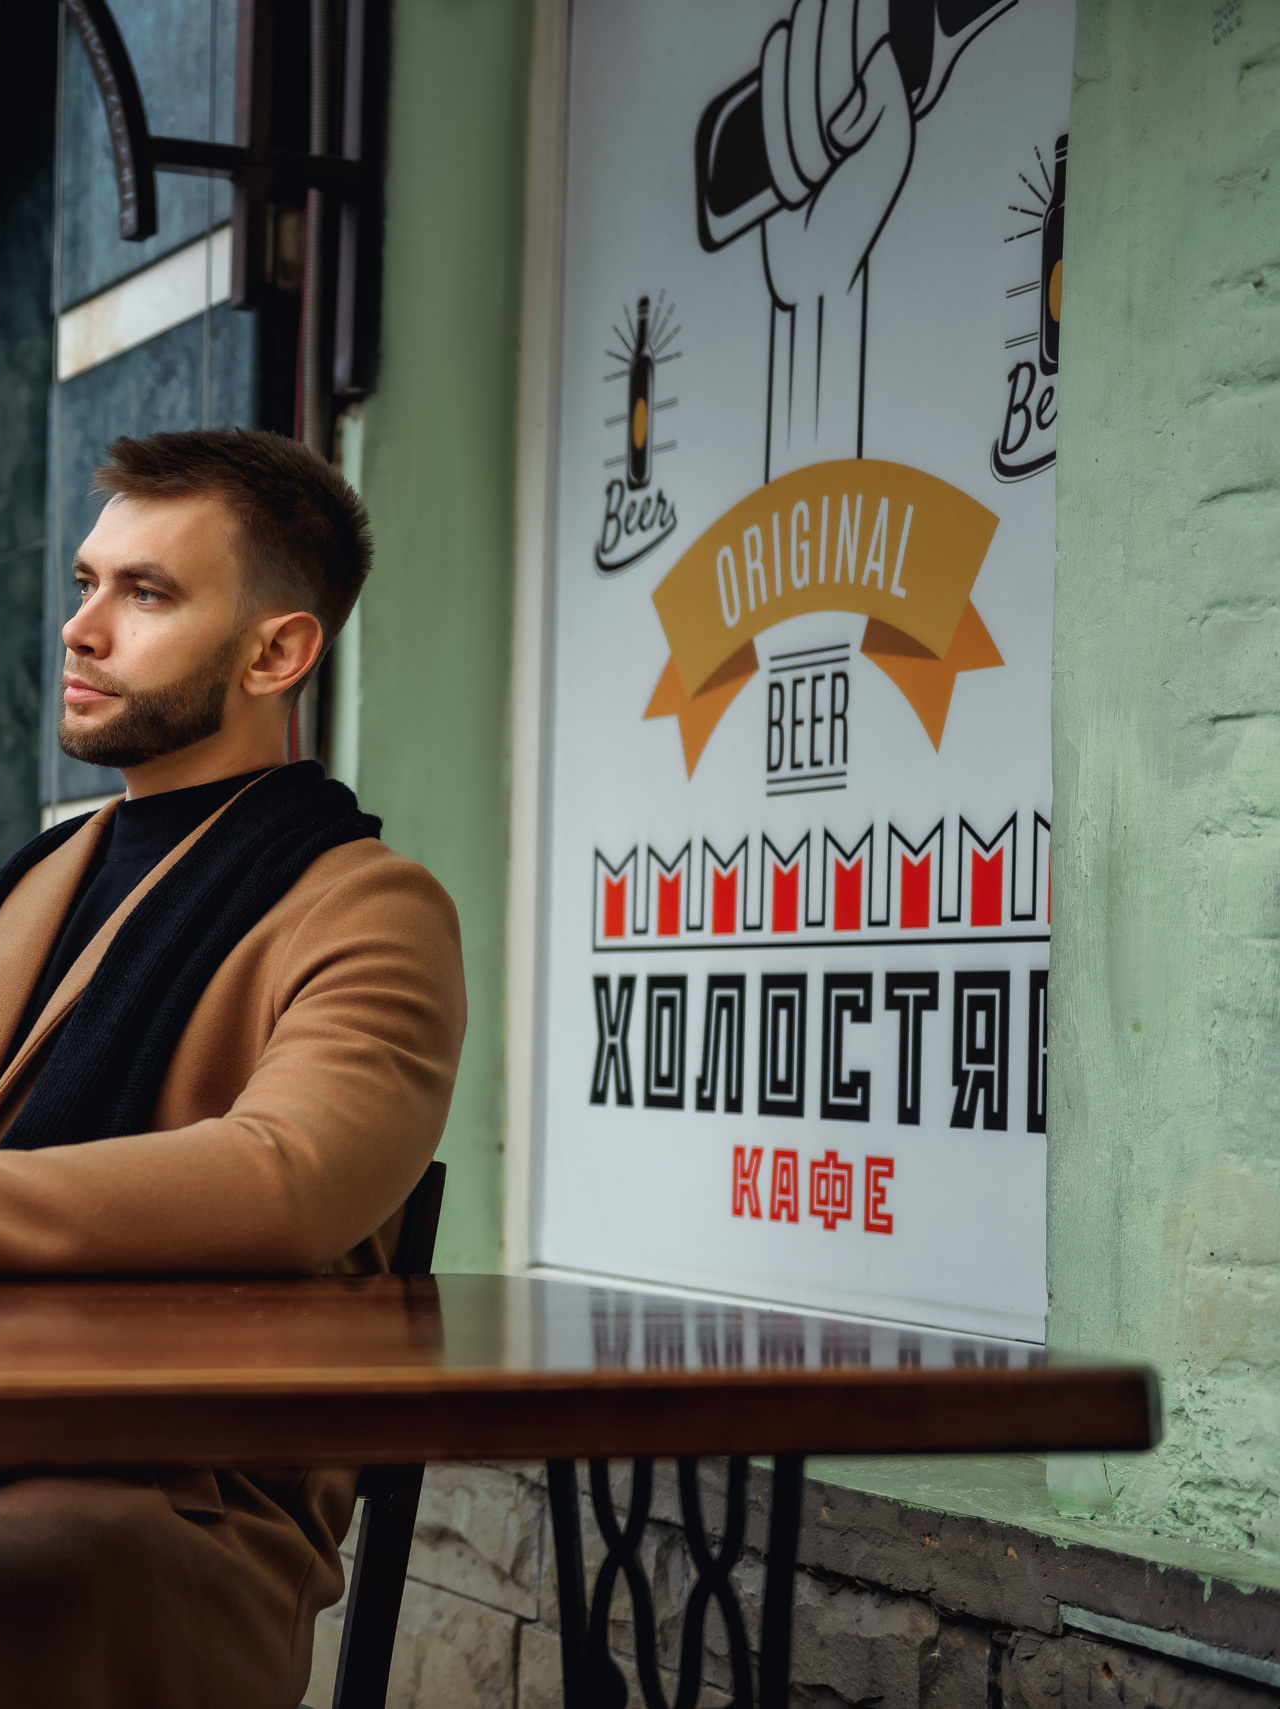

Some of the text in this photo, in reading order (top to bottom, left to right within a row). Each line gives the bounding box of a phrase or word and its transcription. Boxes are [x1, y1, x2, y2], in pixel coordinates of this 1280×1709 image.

[600, 479, 677, 554] Beer
[716, 493, 915, 628] ORIGINAL
[766, 671, 850, 773] BEER
[732, 1145, 895, 1235] КАФЕ
